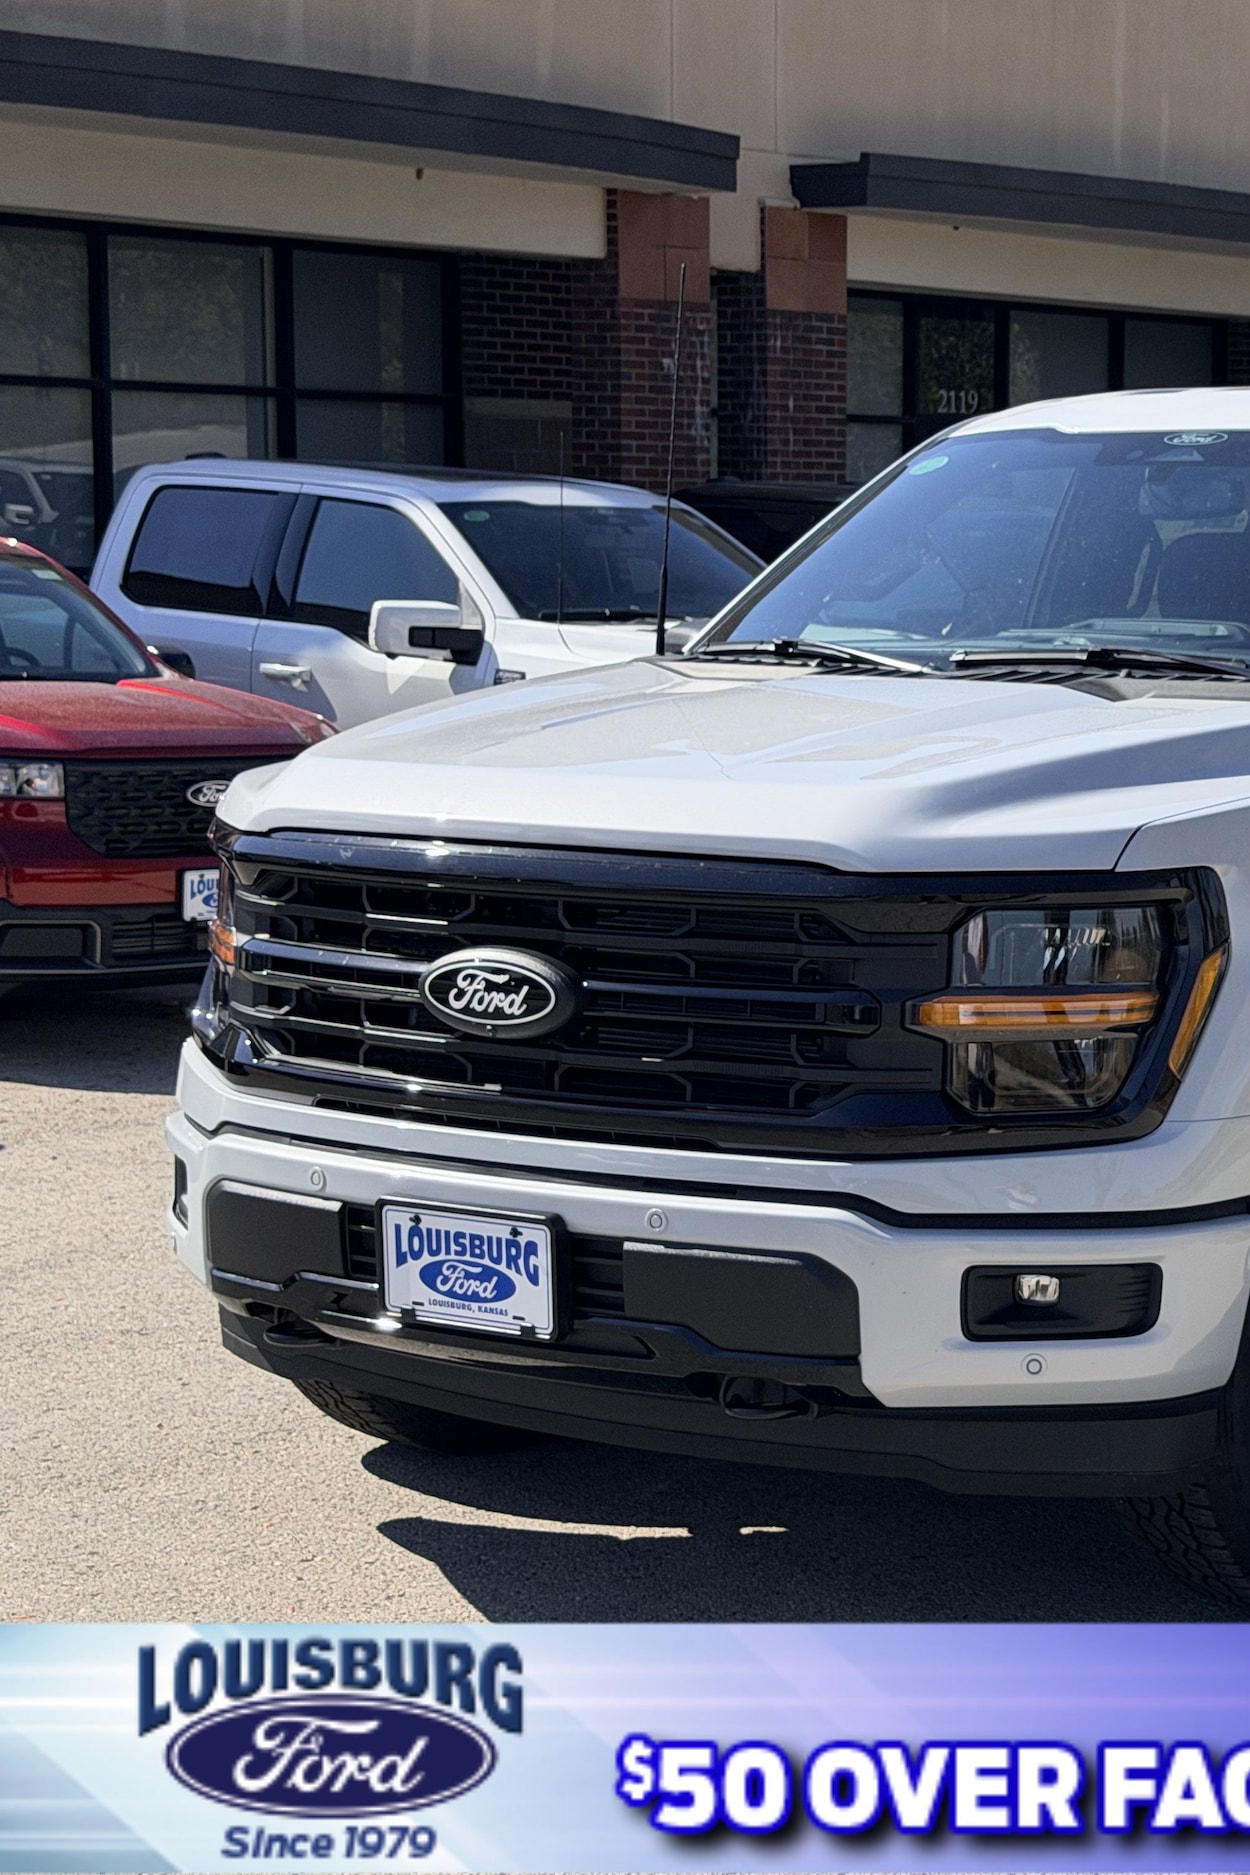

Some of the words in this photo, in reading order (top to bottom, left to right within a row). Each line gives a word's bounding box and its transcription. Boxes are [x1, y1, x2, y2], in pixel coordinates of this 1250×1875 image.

[937, 389, 979, 414] 2119
[448, 968, 530, 1016] Ford
[394, 1223, 540, 1287] LOUISBURG
[436, 1261, 499, 1299] Ford
[428, 1297, 476, 1314] LOUISBURG,
[477, 1305, 509, 1317] KANSAS
